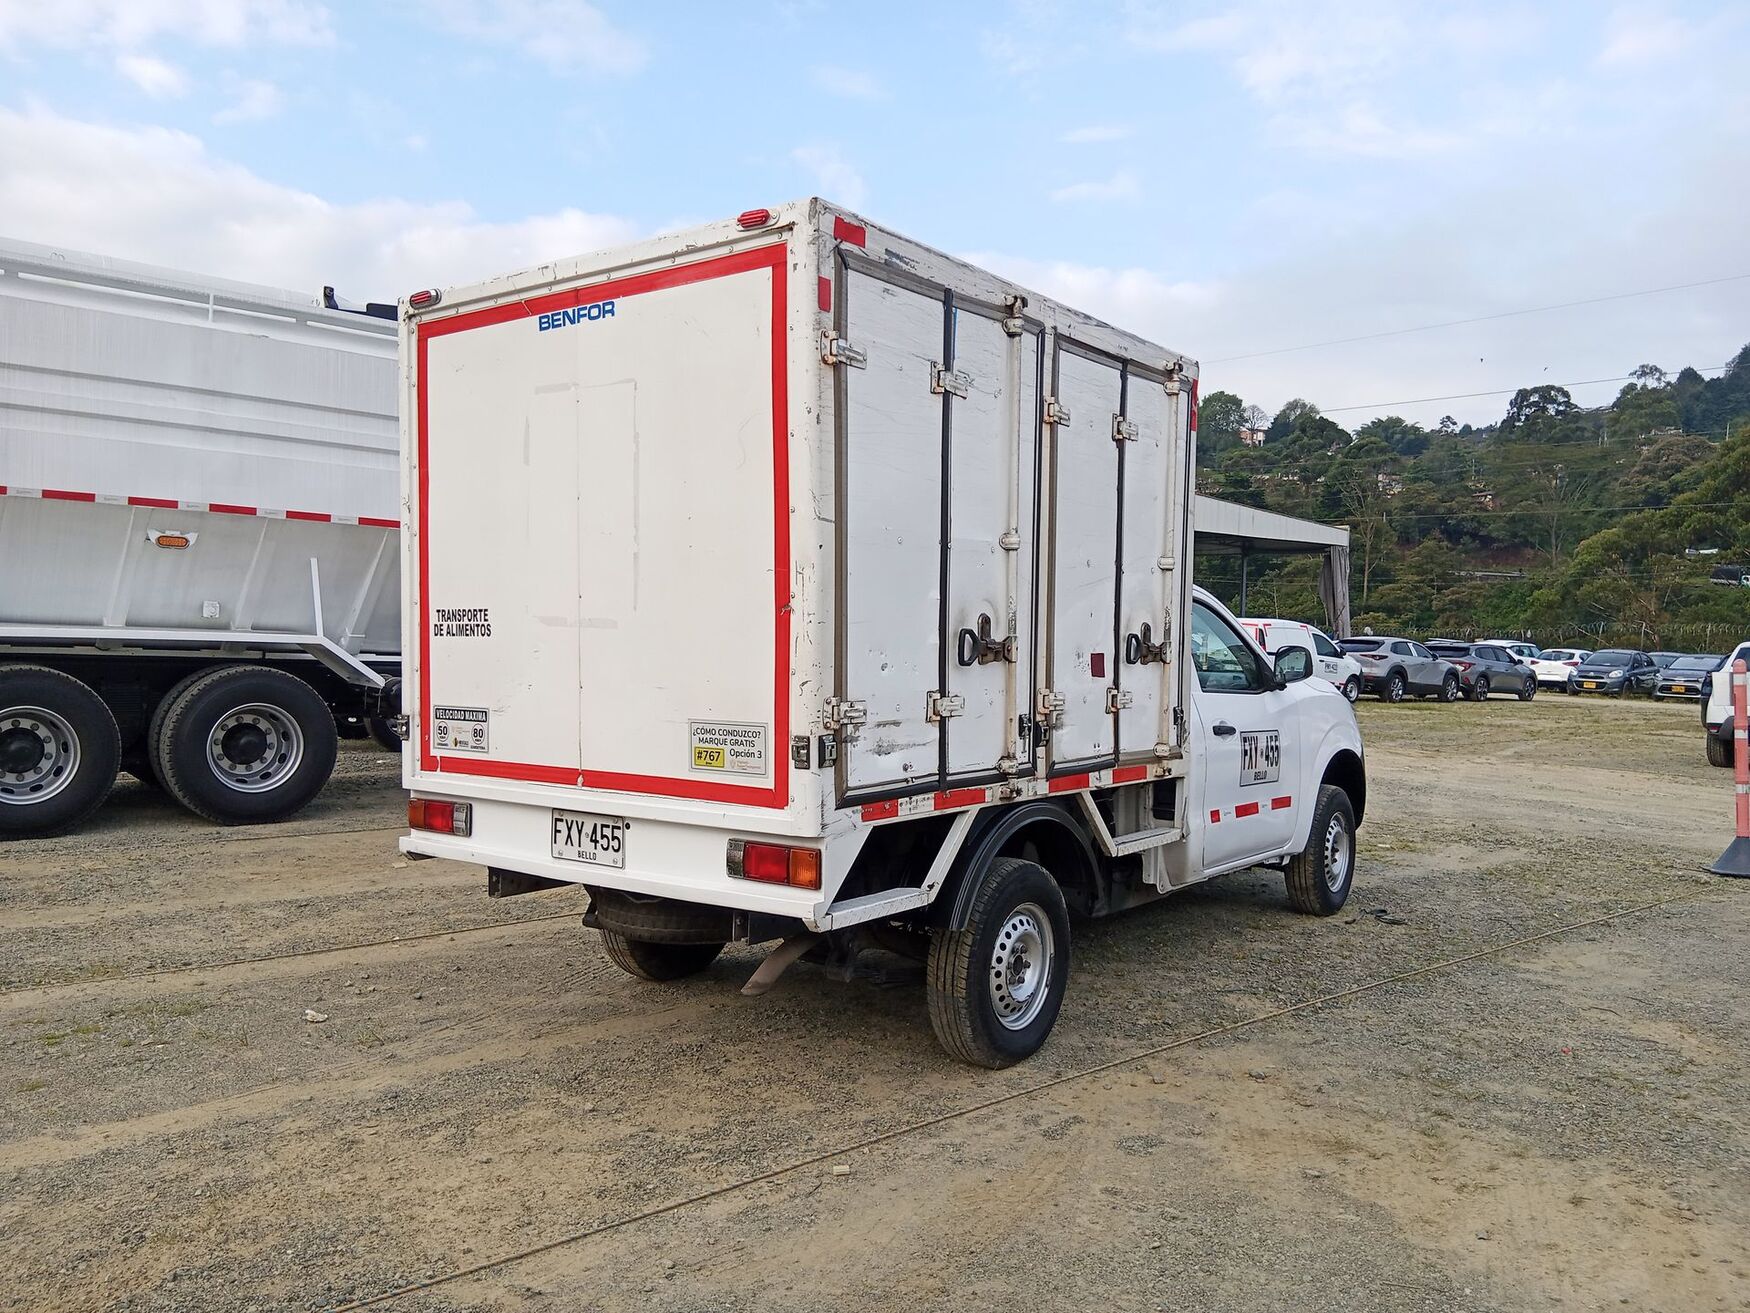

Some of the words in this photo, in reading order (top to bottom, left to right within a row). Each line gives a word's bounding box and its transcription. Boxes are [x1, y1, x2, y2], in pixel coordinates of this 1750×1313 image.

[538, 301, 615, 331] BENFOR
[436, 608, 489, 622] TRANSPORTE
[433, 623, 444, 637] DE
[446, 623, 492, 637] ALIMENTOS
[436, 709, 465, 720] VELOCIDAD
[465, 710, 487, 721] MAXIMA
[437, 725, 448, 736] 50
[473, 728, 484, 738] 80
[717, 728, 762, 739] CONDUZCO?
[698, 736, 728, 746] MARQUE
[729, 738, 756, 748] GRATIS
[697, 749, 721, 762] #767
[729, 748, 756, 758] Opción
[757, 750, 762, 759] 3
[1253, 770, 1268, 781] BELLO
[553, 817, 585, 848] FXY
[589, 822, 622, 853] 455
[577, 850, 597, 861] BELLO
